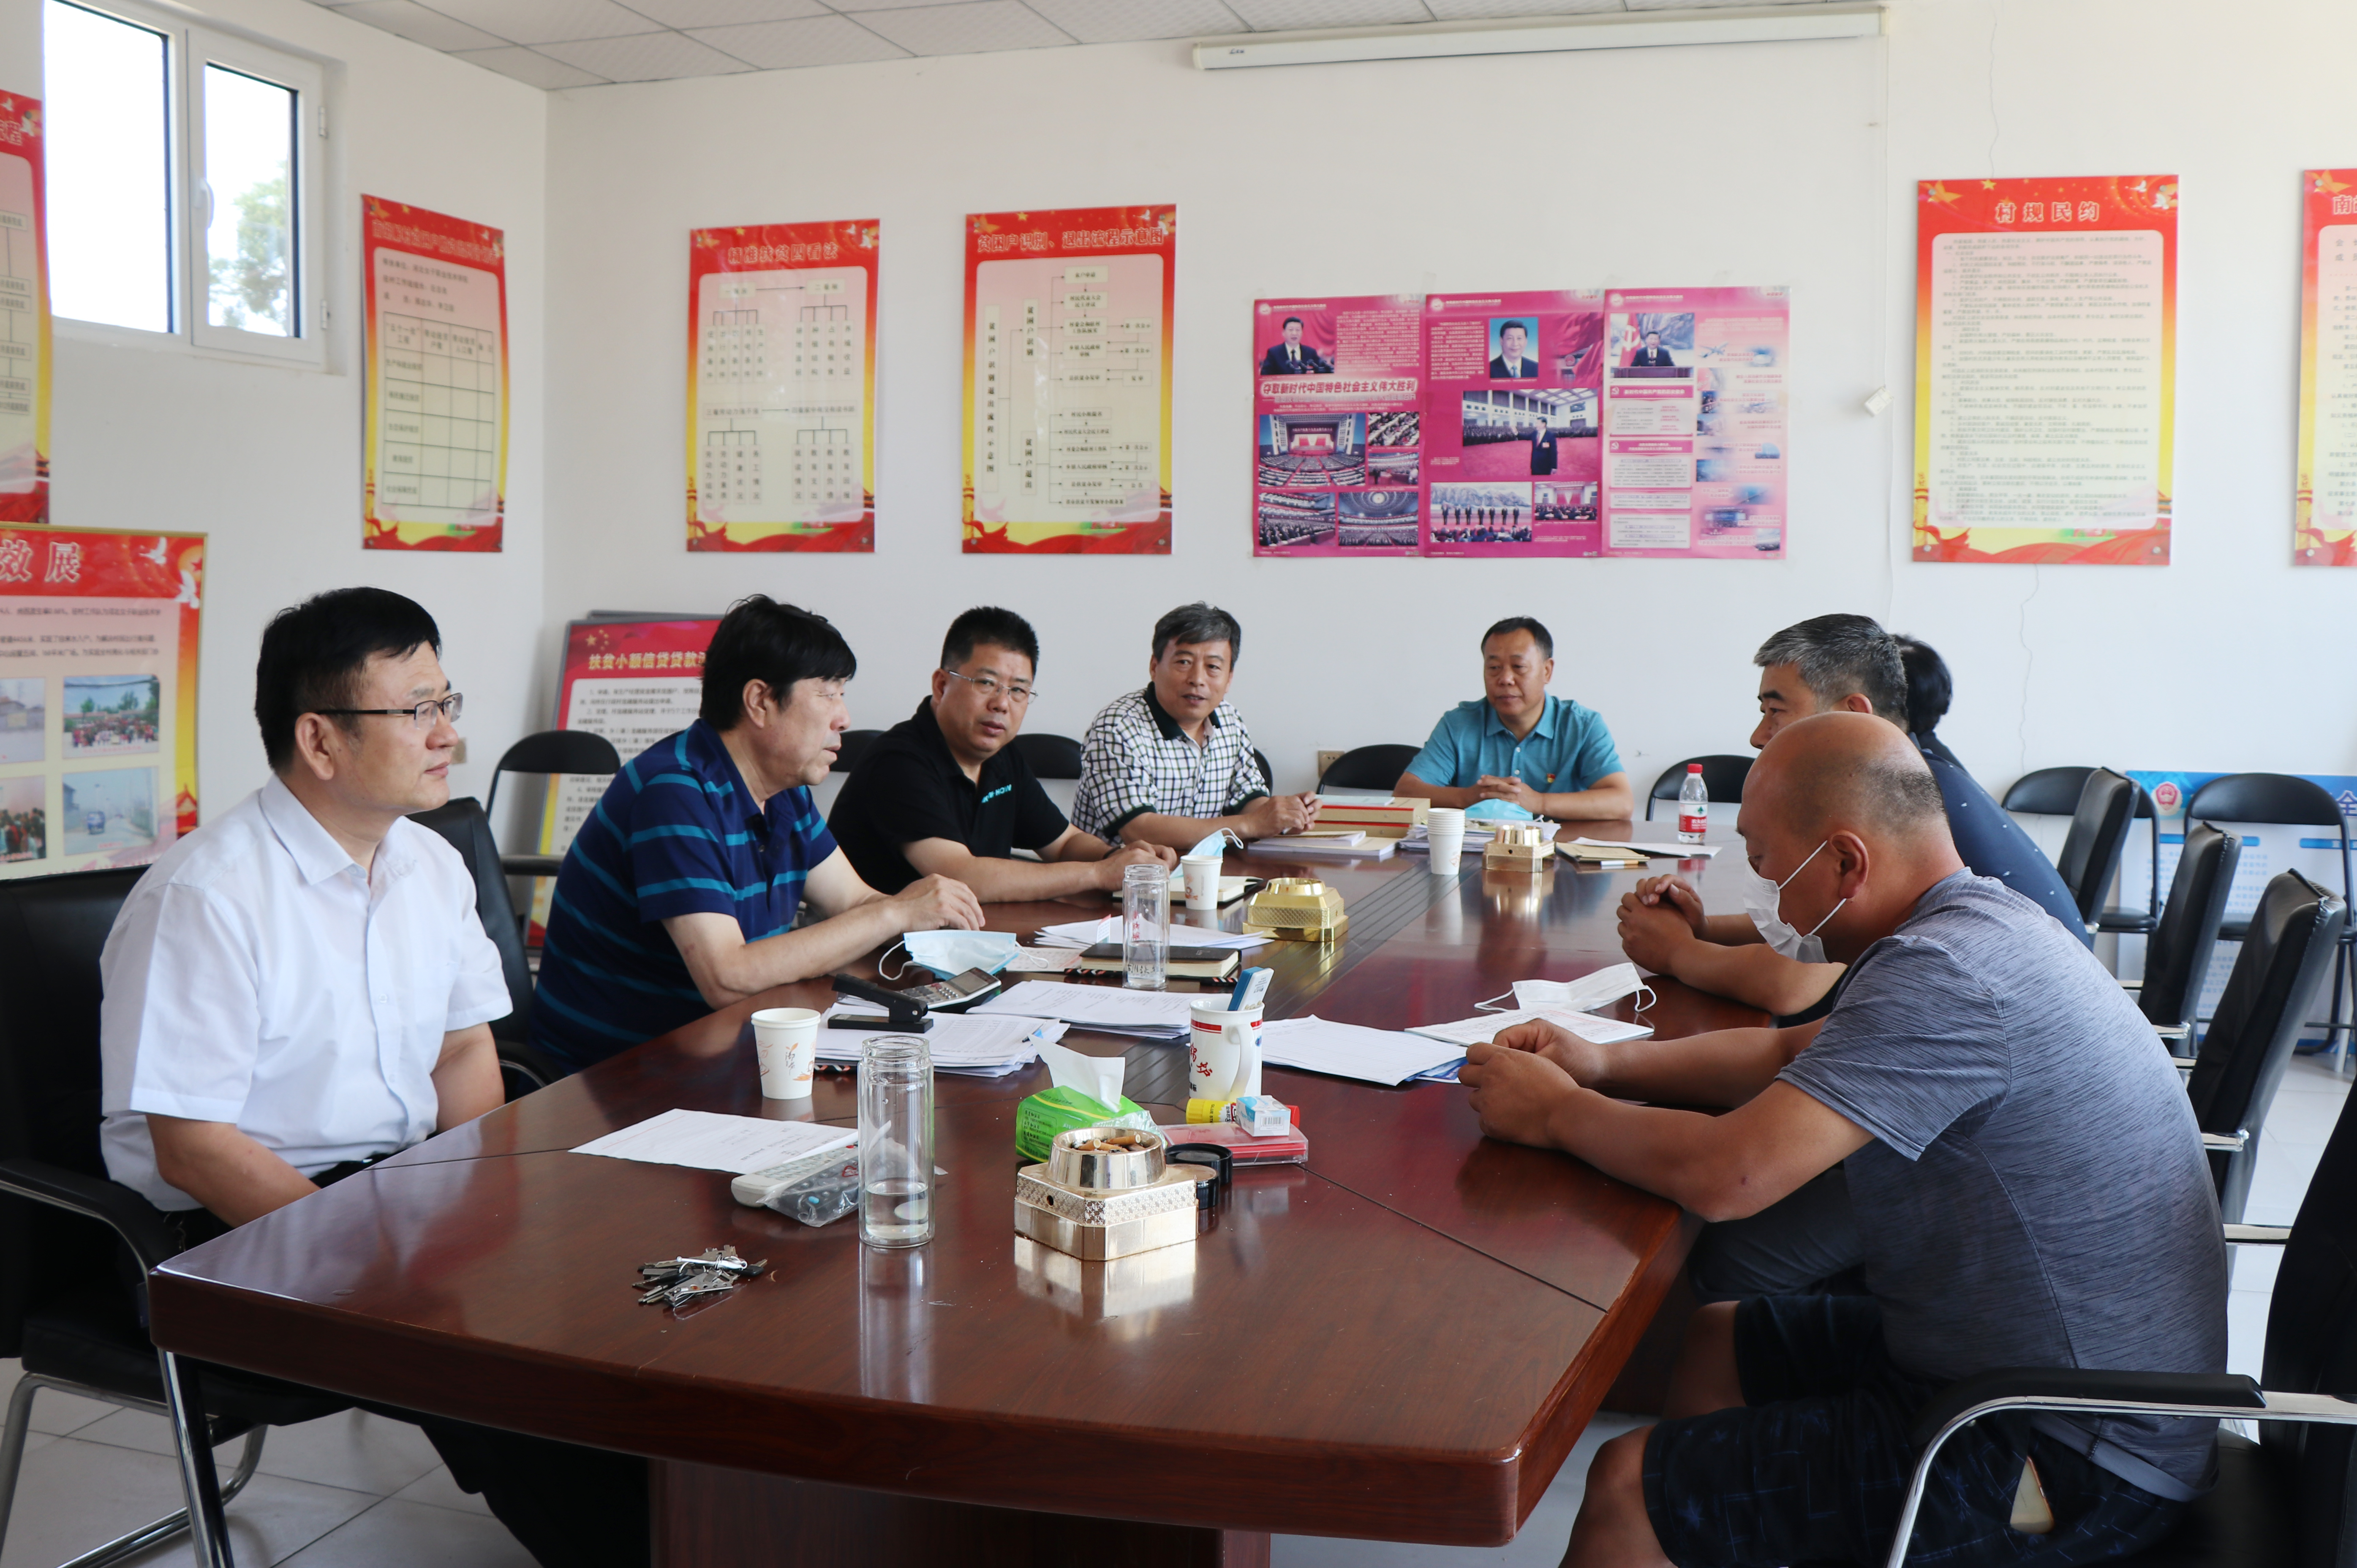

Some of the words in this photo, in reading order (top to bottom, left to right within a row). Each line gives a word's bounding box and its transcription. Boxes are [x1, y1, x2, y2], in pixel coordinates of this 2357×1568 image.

[1995, 201, 2100, 223] 村规民约
[2333, 195, 2357, 215] 南
[977, 227, 1164, 253] 贫困户识别、退出流程示意图
[727, 242, 839, 264] 精准扶贫四看法
[1263, 380, 1416, 394] 夺取新时代中国特色社会主义伟大胜利
